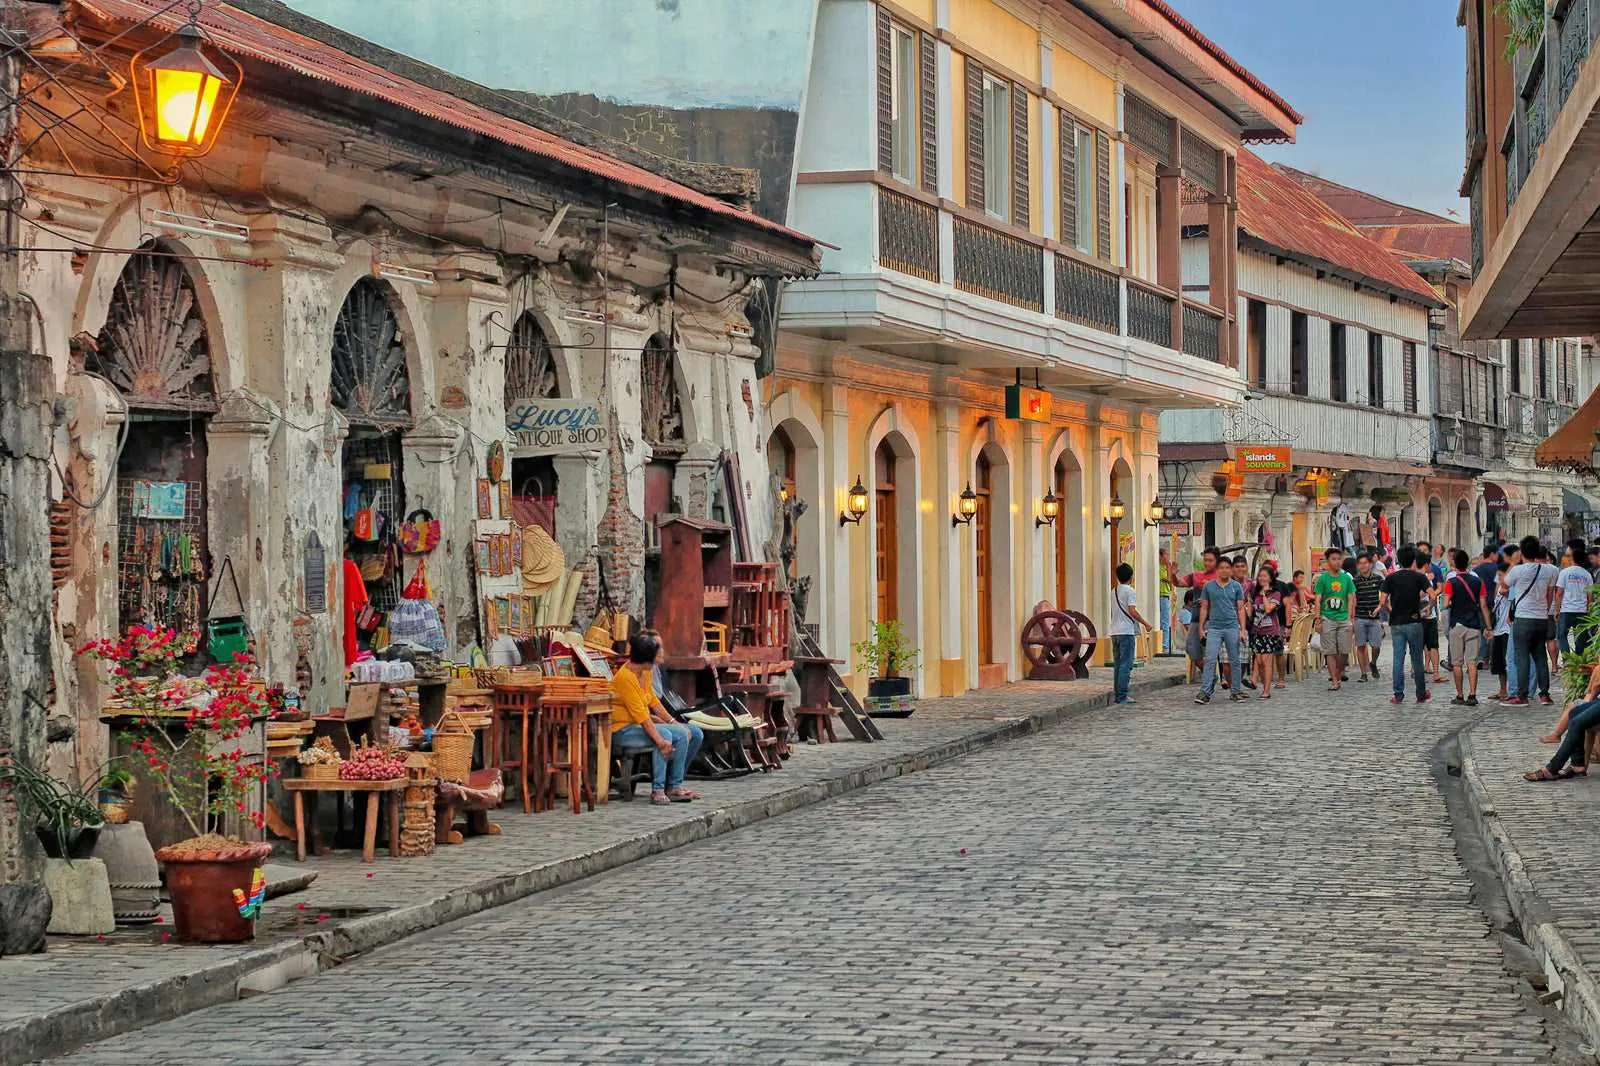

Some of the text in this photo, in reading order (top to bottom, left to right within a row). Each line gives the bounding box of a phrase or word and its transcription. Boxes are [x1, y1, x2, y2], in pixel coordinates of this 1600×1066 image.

[508, 405, 600, 430] Lucy's
[568, 427, 608, 444] SHOP
[1246, 453, 1276, 461] islands
